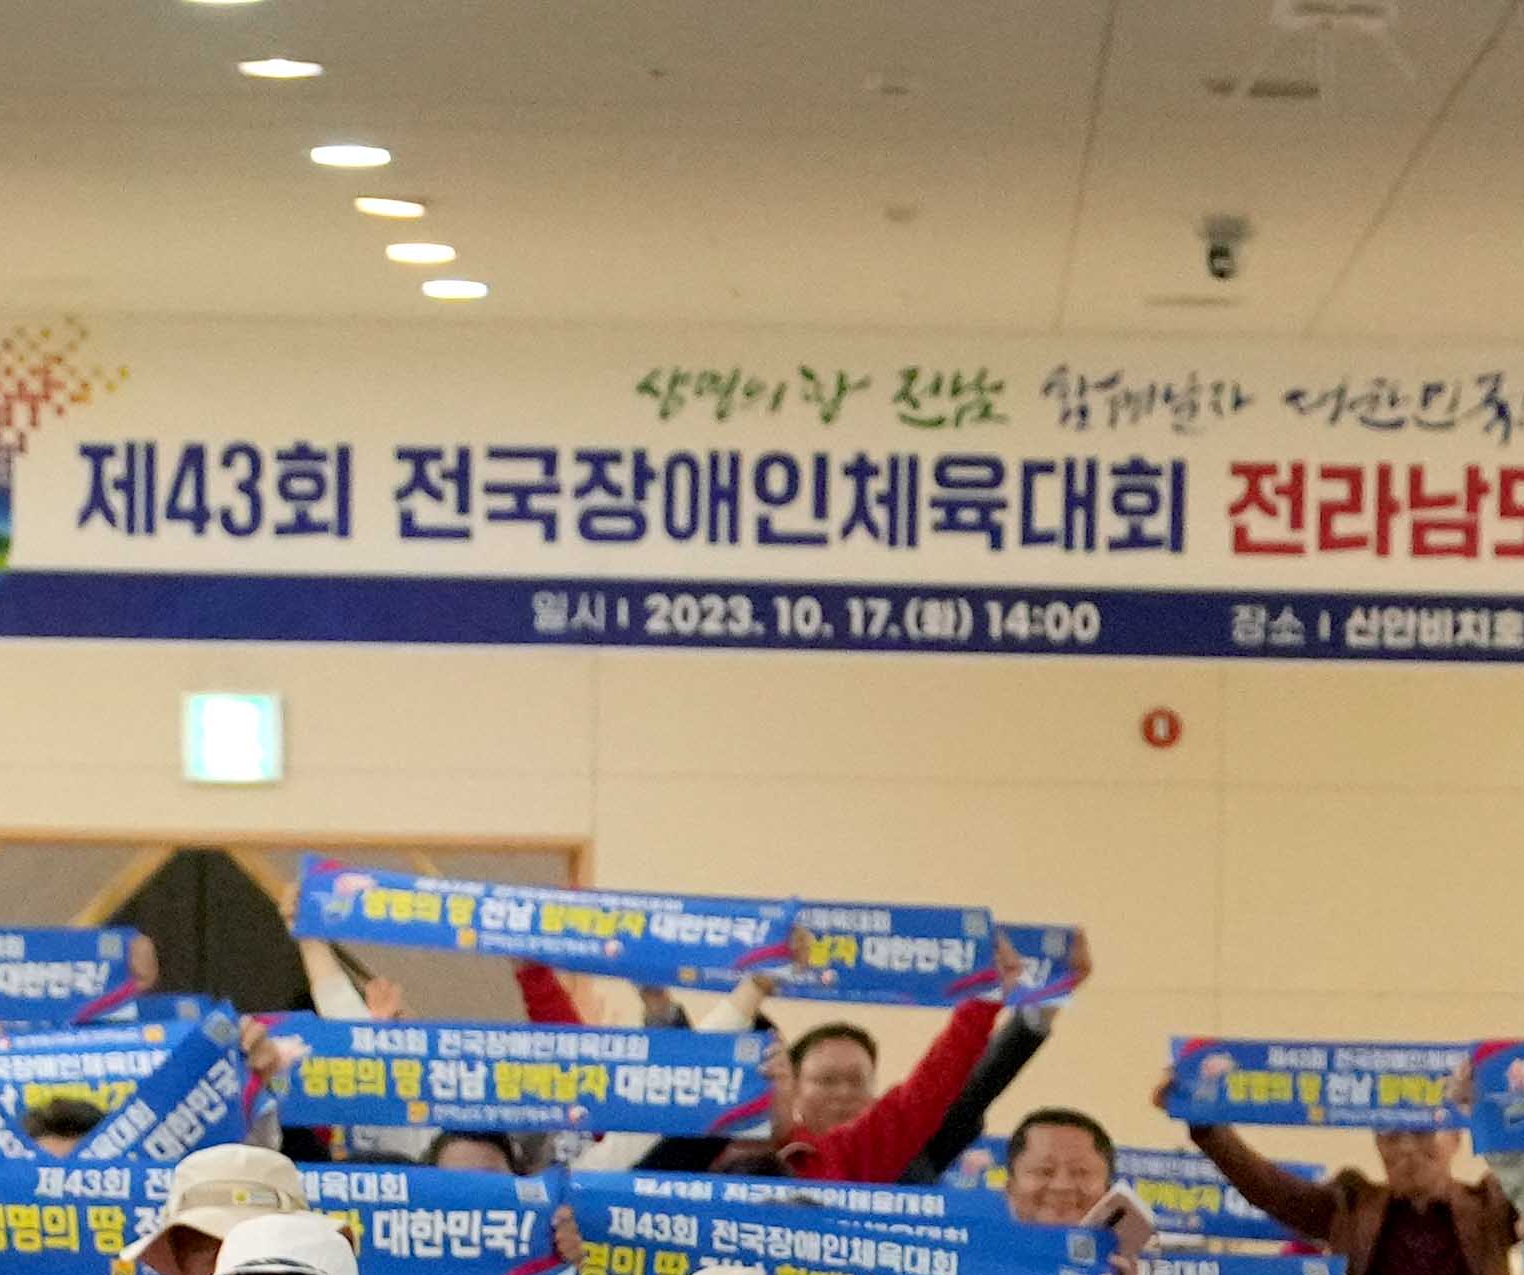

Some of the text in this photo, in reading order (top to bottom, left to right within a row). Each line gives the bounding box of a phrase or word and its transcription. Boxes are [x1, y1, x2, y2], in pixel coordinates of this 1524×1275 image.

[78, 442, 351, 538] 제43회
[396, 447, 1186, 553] 전국장애인체육대회
[533, 592, 606, 634] 일시
[645, 593, 764, 635] 2023.
[774, 597, 833, 638] 10.
[986, 601, 1100, 643] 14:00
[1232, 605, 1304, 646] 장소
[352, 1027, 427, 1055] 제43회
[295, 1052, 386, 1097] 생명의
[429, 1060, 487, 1100] 전남
[494, 1059, 609, 1102] 함께날자
[615, 1065, 743, 1105] 대한민국!
